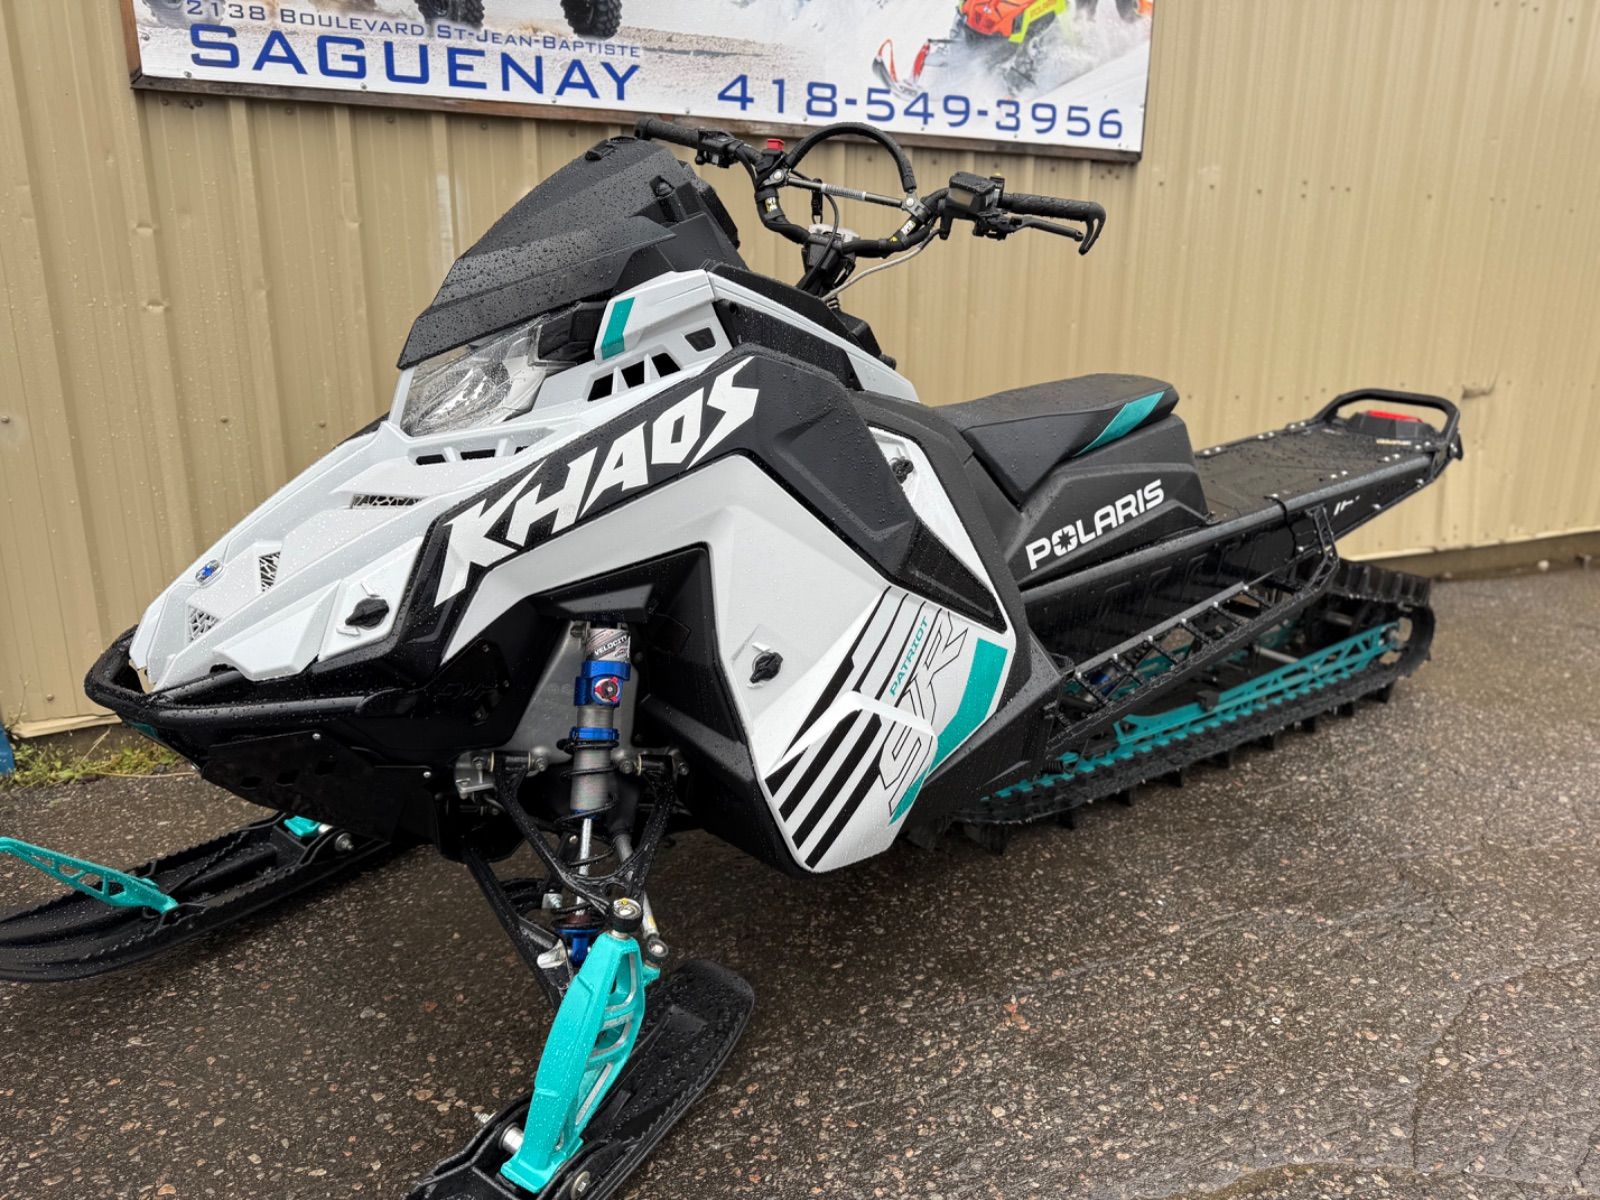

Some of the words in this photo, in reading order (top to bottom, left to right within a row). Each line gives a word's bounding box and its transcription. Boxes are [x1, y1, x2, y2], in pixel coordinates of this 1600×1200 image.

[187, 0, 265, 21] 2138
[280, 9, 425, 36] BOULEVARD
[437, 24, 641, 57] ST-JEAN-BAPTISTE
[190, 23, 641, 101] SAGUENAY
[717, 73, 1123, 140] 418-549-3956
[434, 356, 759, 607] KHAOS
[1025, 479, 1164, 571] POLARIS
[889, 616, 928, 697] PATRIOT
